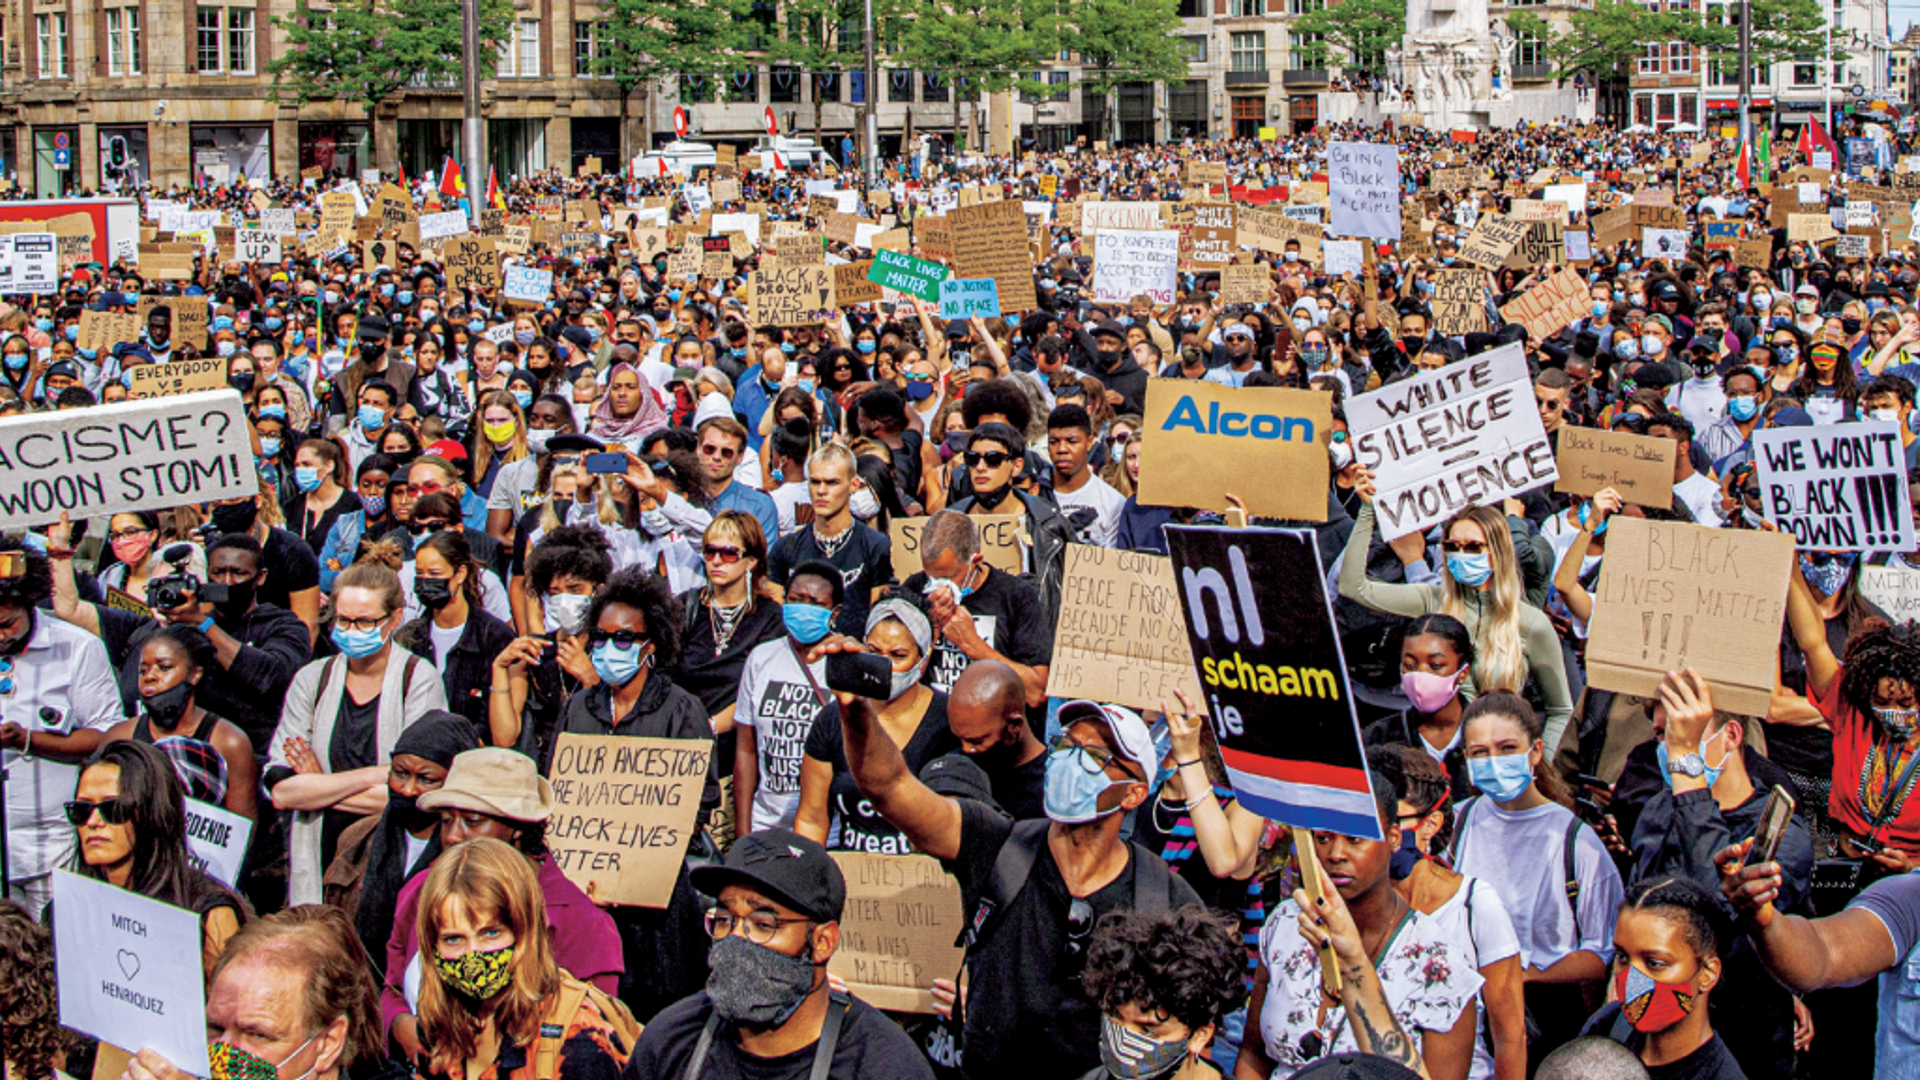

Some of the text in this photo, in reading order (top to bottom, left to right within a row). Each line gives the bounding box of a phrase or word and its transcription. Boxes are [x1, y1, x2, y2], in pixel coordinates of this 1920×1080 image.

[1086, 207, 1159, 229] SICKENING
[1194, 206, 1232, 218] WHITE
[1194, 217, 1233, 229] SILENCE
[1491, 212, 1527, 233] WHITE
[1638, 207, 1679, 223] FUCK
[240, 231, 278, 244] SPEAK
[1099, 234, 1117, 247] TO
[1527, 222, 1563, 243] BULL
[246, 245, 270, 259] UP
[460, 241, 479, 253] NO
[1194, 240, 1230, 251] WHITE
[1527, 243, 1564, 263] SHIT
[446, 252, 494, 268] JUSTICE
[465, 266, 483, 277] NO
[880, 251, 944, 281] BLACK LIVES
[455, 272, 495, 289] PEACE
[508, 268, 549, 281] STOP
[755, 268, 808, 284] BLACK
[835, 265, 871, 284] ILENC
[886, 272, 928, 296] MATTER
[756, 282, 812, 296] BROWN
[836, 284, 878, 299] TRAYAL
[944, 282, 958, 294] NO
[1503, 270, 1584, 322] SILENCE
[757, 292, 803, 310] LIVES
[944, 300, 959, 315] NO
[963, 298, 993, 313] PEACE
[758, 309, 816, 324] MATTER
[135, 361, 222, 381] EVERYBODY
[157, 379, 183, 390] VS
[1376, 360, 1493, 419] WHITE
[1161, 394, 1314, 443] Alcon
[1358, 388, 1514, 471] SILENCE
[1762, 432, 1897, 472] WE WON'T
[119, 453, 242, 501] STOM!
[1378, 440, 1556, 528] VIOLENCE
[1770, 476, 1853, 517] BLACK
[1775, 515, 1859, 547] DOWN
[1070, 544, 1106, 574] YOU
[1647, 526, 1740, 579] BLACK
[1066, 575, 1116, 610] PEACE
[1182, 545, 1264, 646] nl
[1603, 571, 1783, 626] LIVES MATTER
[1060, 607, 1129, 638] BECAUSE
[1058, 633, 1116, 663] PEACE
[1052, 663, 1084, 690] HIS
[1202, 651, 1339, 701] schaam
[778, 684, 815, 703] NOT
[1211, 693, 1244, 740] je
[763, 736, 806, 757] WHIT
[558, 745, 708, 778] OUR ANCESTORS
[576, 780, 683, 807] WATCHING
[765, 776, 802, 793] HUM
[545, 813, 679, 849] BLACK LIVES
[843, 821, 912, 855] breat
[551, 849, 622, 872] ATTER
[859, 857, 905, 888] LIVES
[844, 898, 942, 928] TTER UNTIL
[111, 913, 148, 938] MITCH
[840, 930, 867, 953] LACK
[854, 958, 925, 990] MATTER
[102, 980, 165, 1016] HENRIQUEZ
